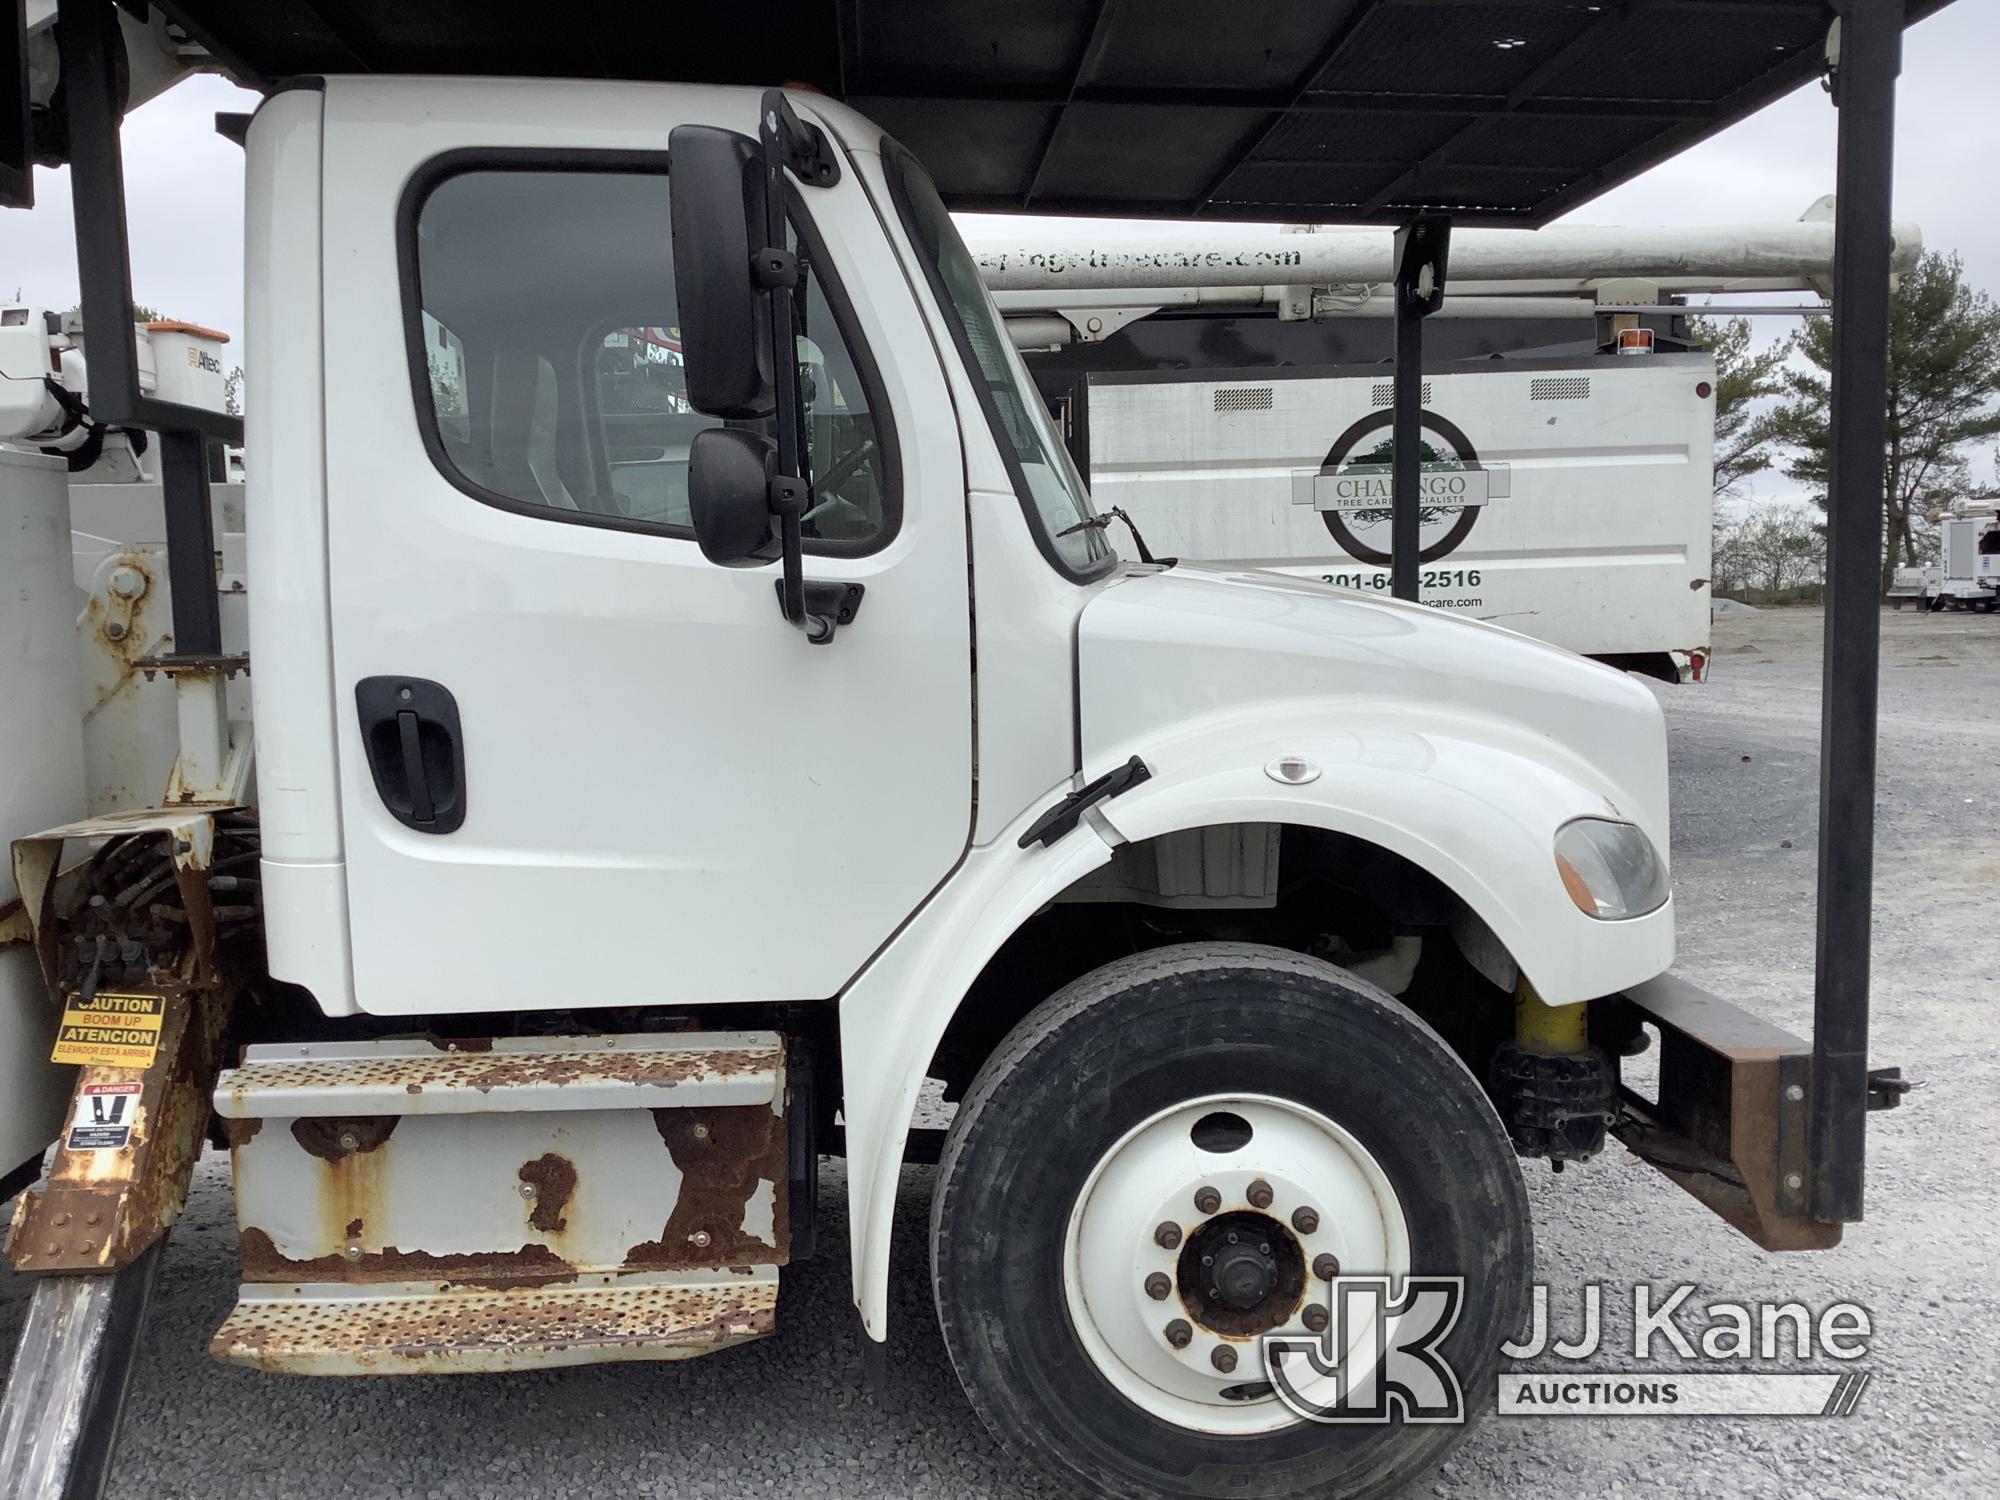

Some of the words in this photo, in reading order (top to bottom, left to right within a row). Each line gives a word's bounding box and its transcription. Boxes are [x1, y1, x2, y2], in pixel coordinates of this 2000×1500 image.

[1336, 477, 1466, 497] CHANGO
[1336, 499, 1363, 507] TREE
[1321, 570, 1481, 589] 01-6-2516
[1420, 598, 1483, 608] ecare.com
[83, 1015, 120, 1025] BOOM
[124, 1016, 141, 1027] UP
[65, 1028, 153, 1044] ATENCION
[101, 1085, 135, 1093] DANGER
